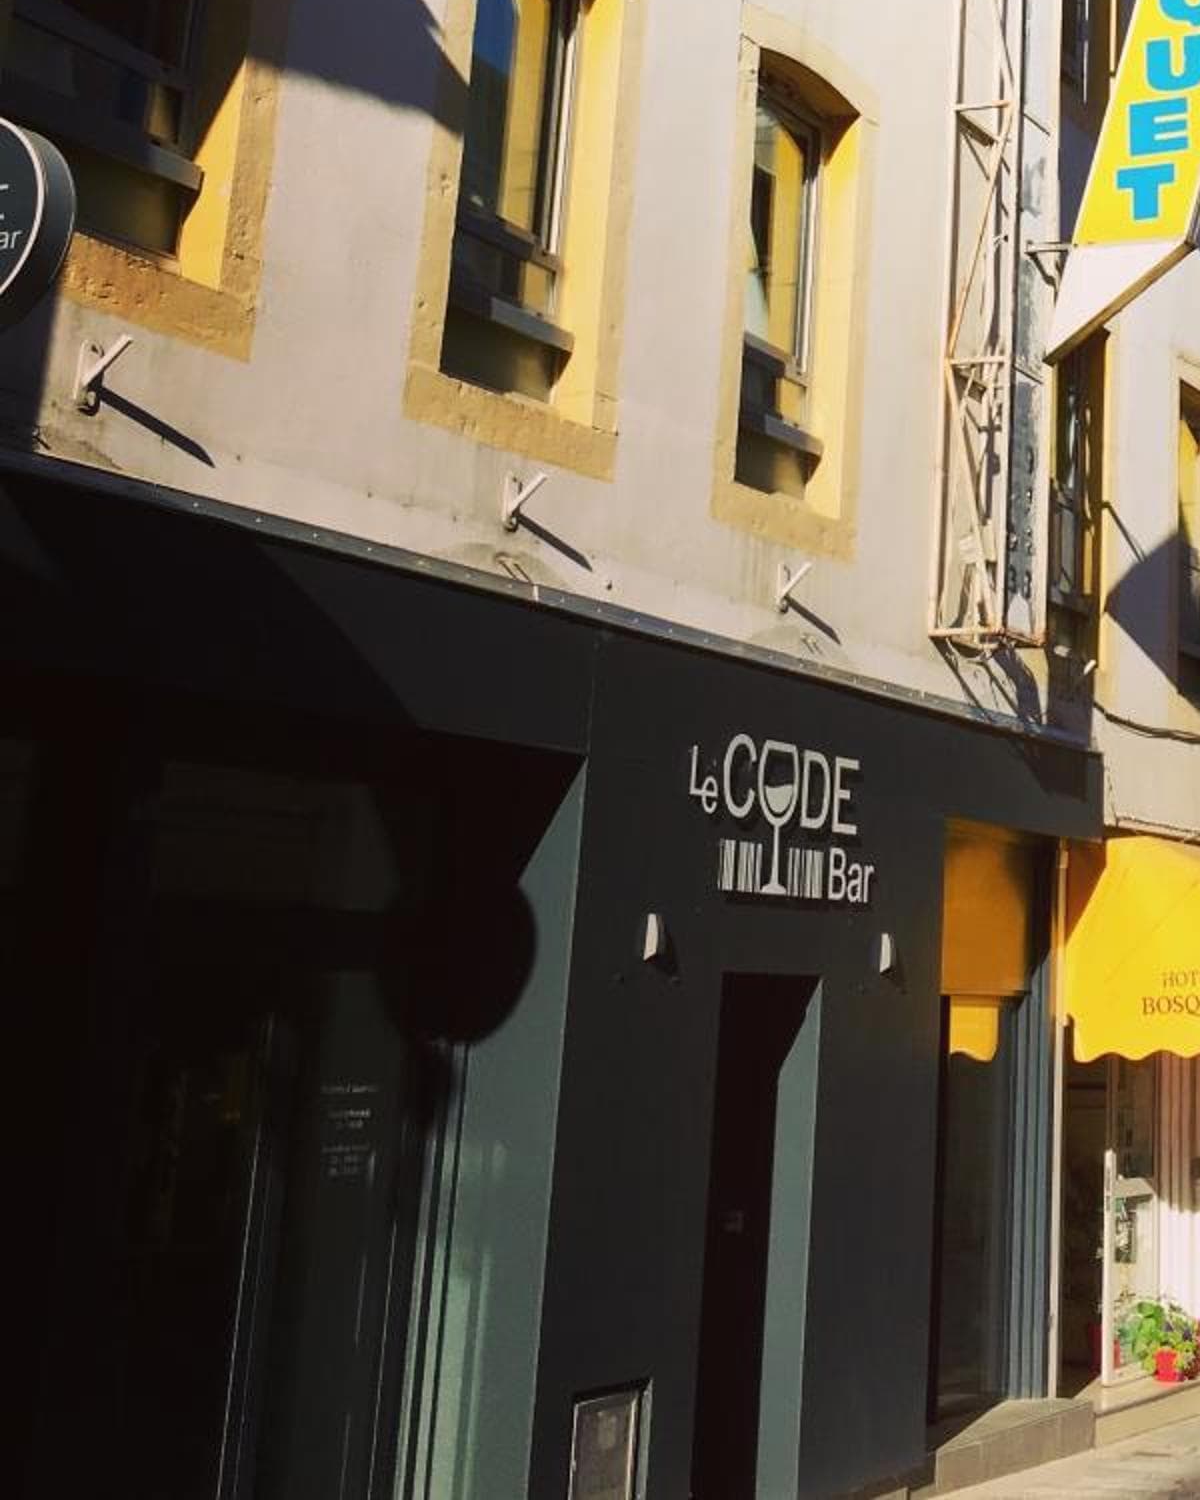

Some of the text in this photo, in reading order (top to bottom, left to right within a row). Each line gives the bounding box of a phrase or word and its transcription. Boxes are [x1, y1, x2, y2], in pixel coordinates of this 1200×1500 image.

[688, 733, 860, 835] Le CODE
[827, 847, 875, 903] Bar
